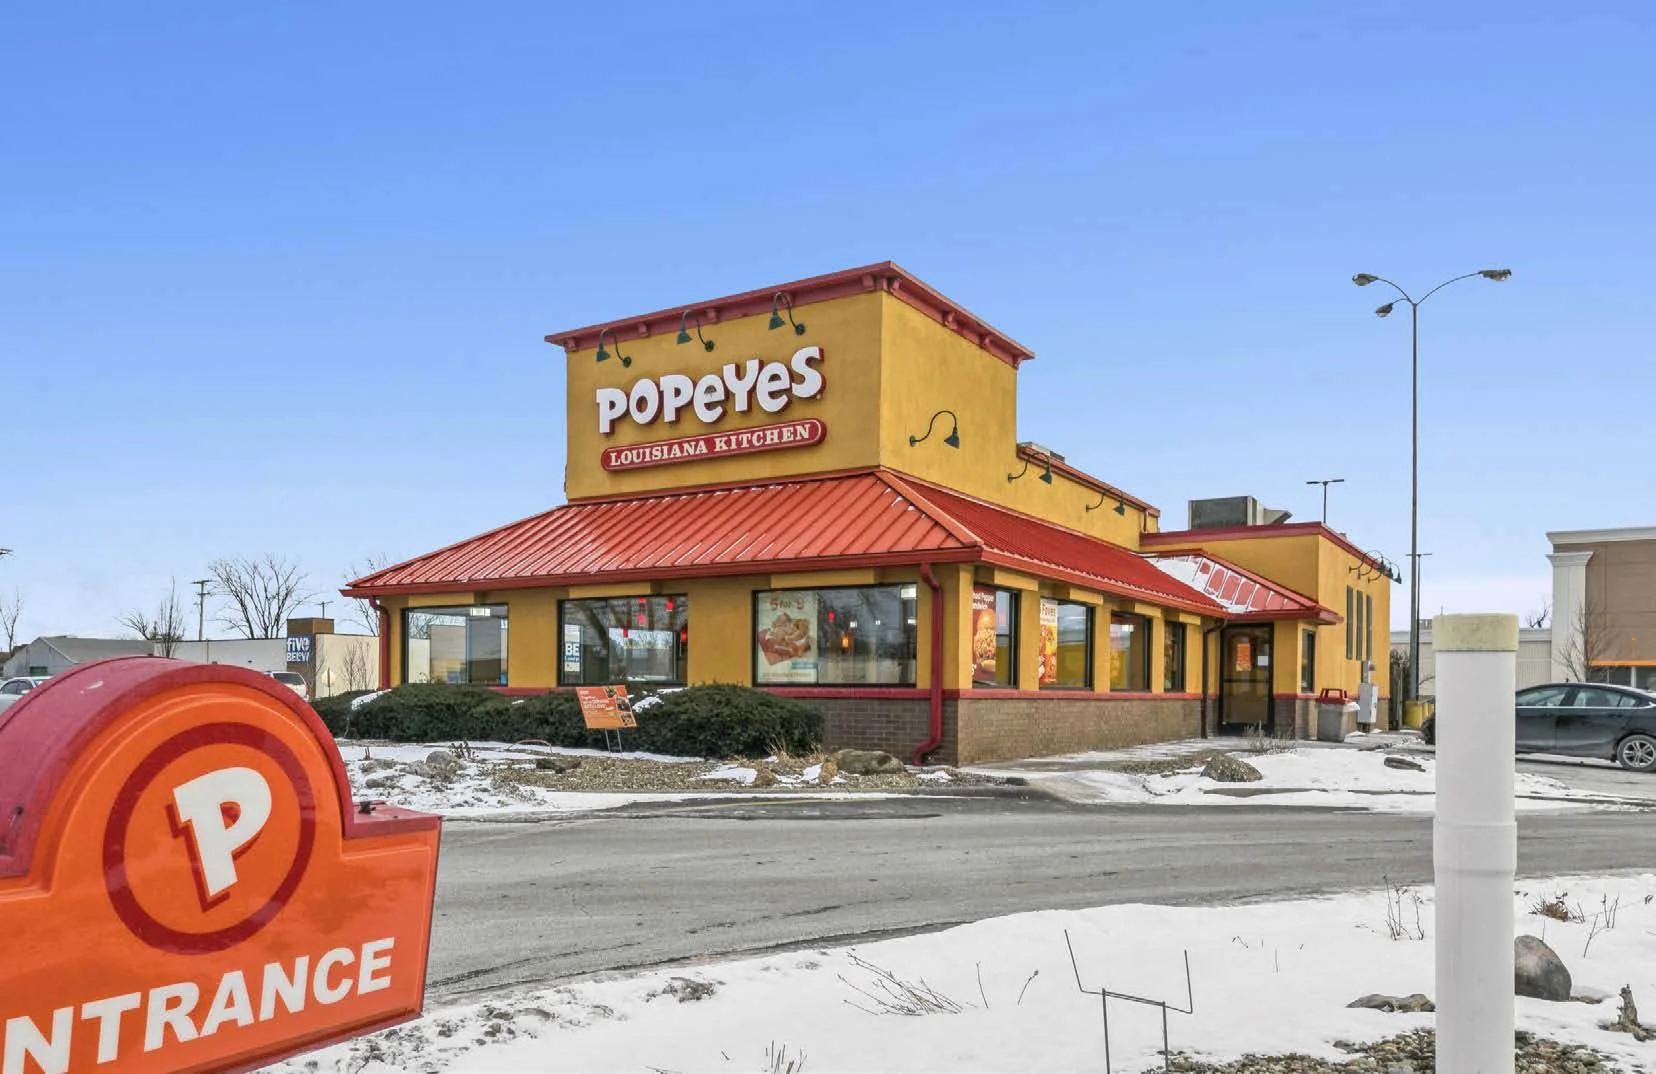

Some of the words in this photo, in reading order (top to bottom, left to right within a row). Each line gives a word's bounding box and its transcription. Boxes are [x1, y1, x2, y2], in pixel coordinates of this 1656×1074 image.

[609, 441, 709, 467] LOUISIANA
[713, 423, 811, 452] KITCHEN
[172, 766, 273, 898] P
[1, 936, 396, 1074] NTRANCE
